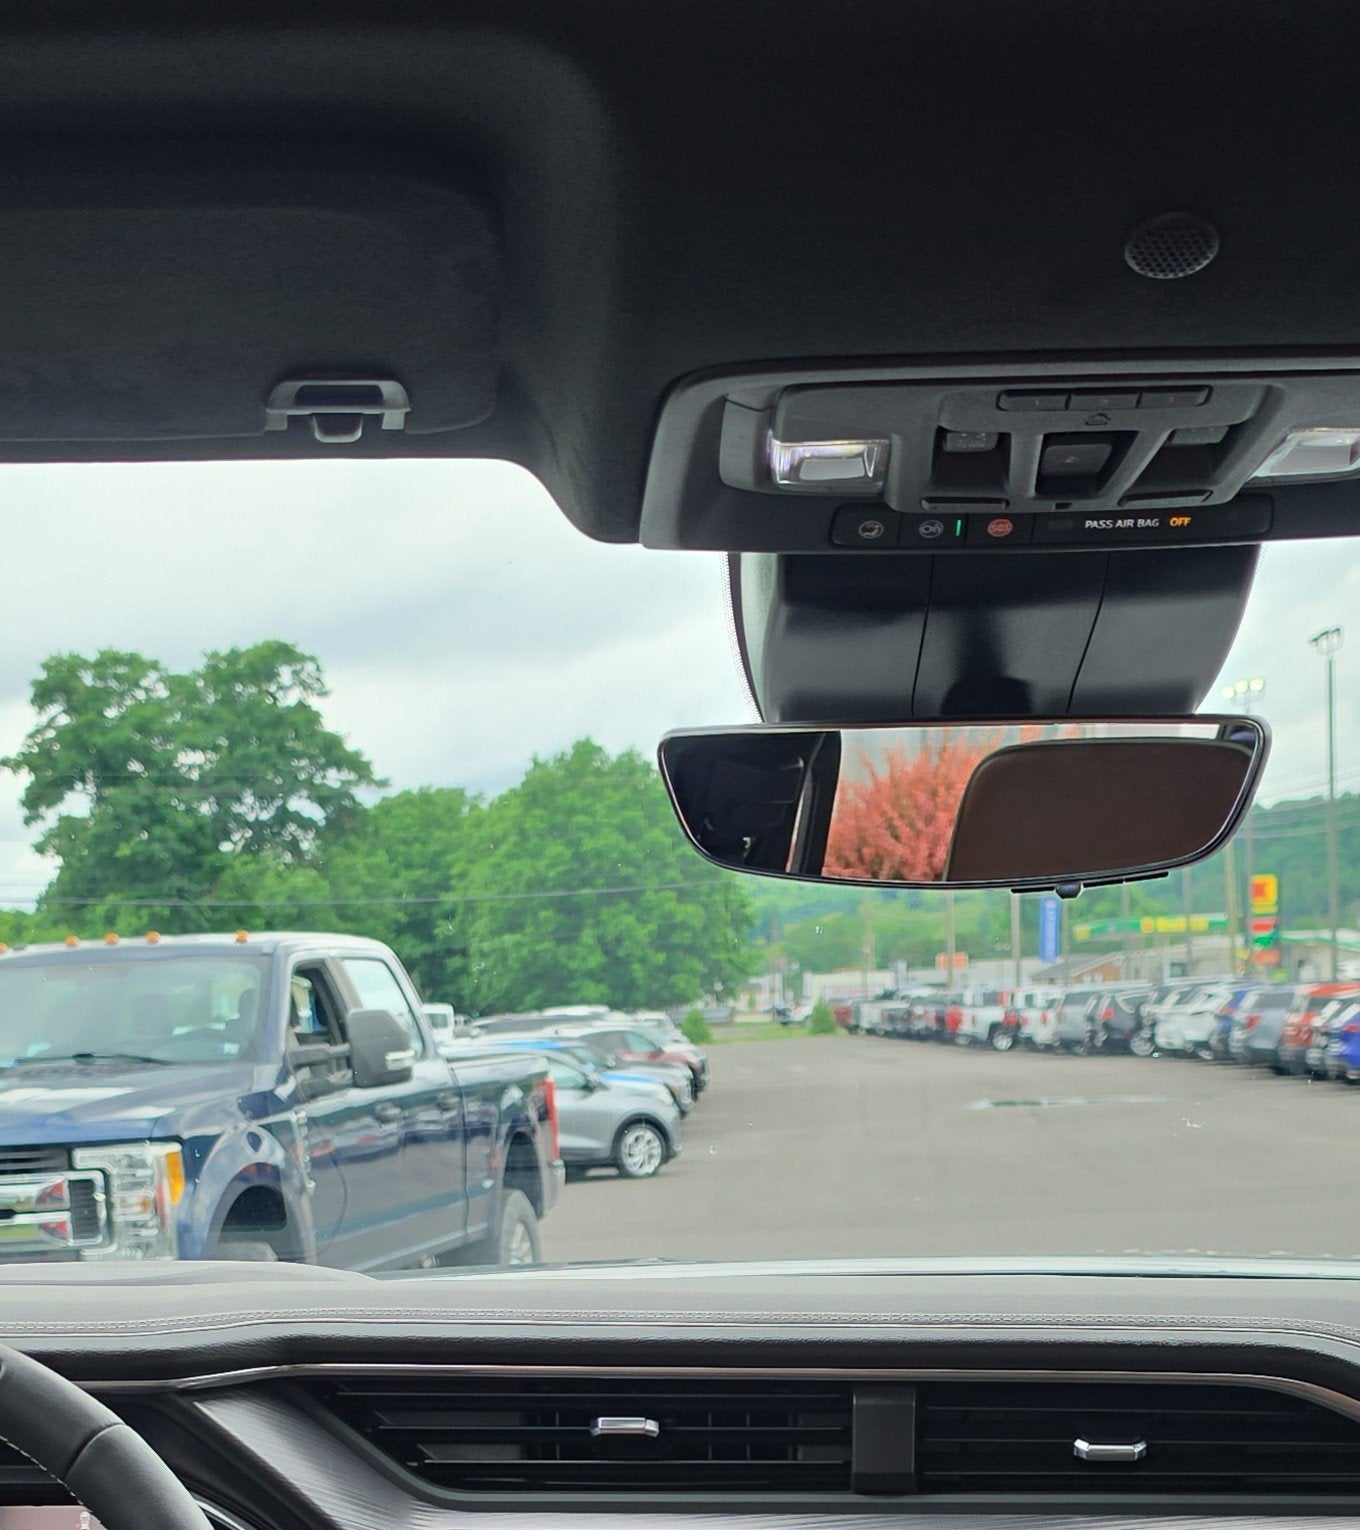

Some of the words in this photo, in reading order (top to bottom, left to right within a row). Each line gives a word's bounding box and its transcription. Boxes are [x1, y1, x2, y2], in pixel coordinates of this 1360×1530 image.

[1085, 519, 1113, 531] PASS
[1115, 518, 1135, 529] AIR
[1137, 517, 1160, 529] BAG
[1169, 516, 1191, 527] OFF
